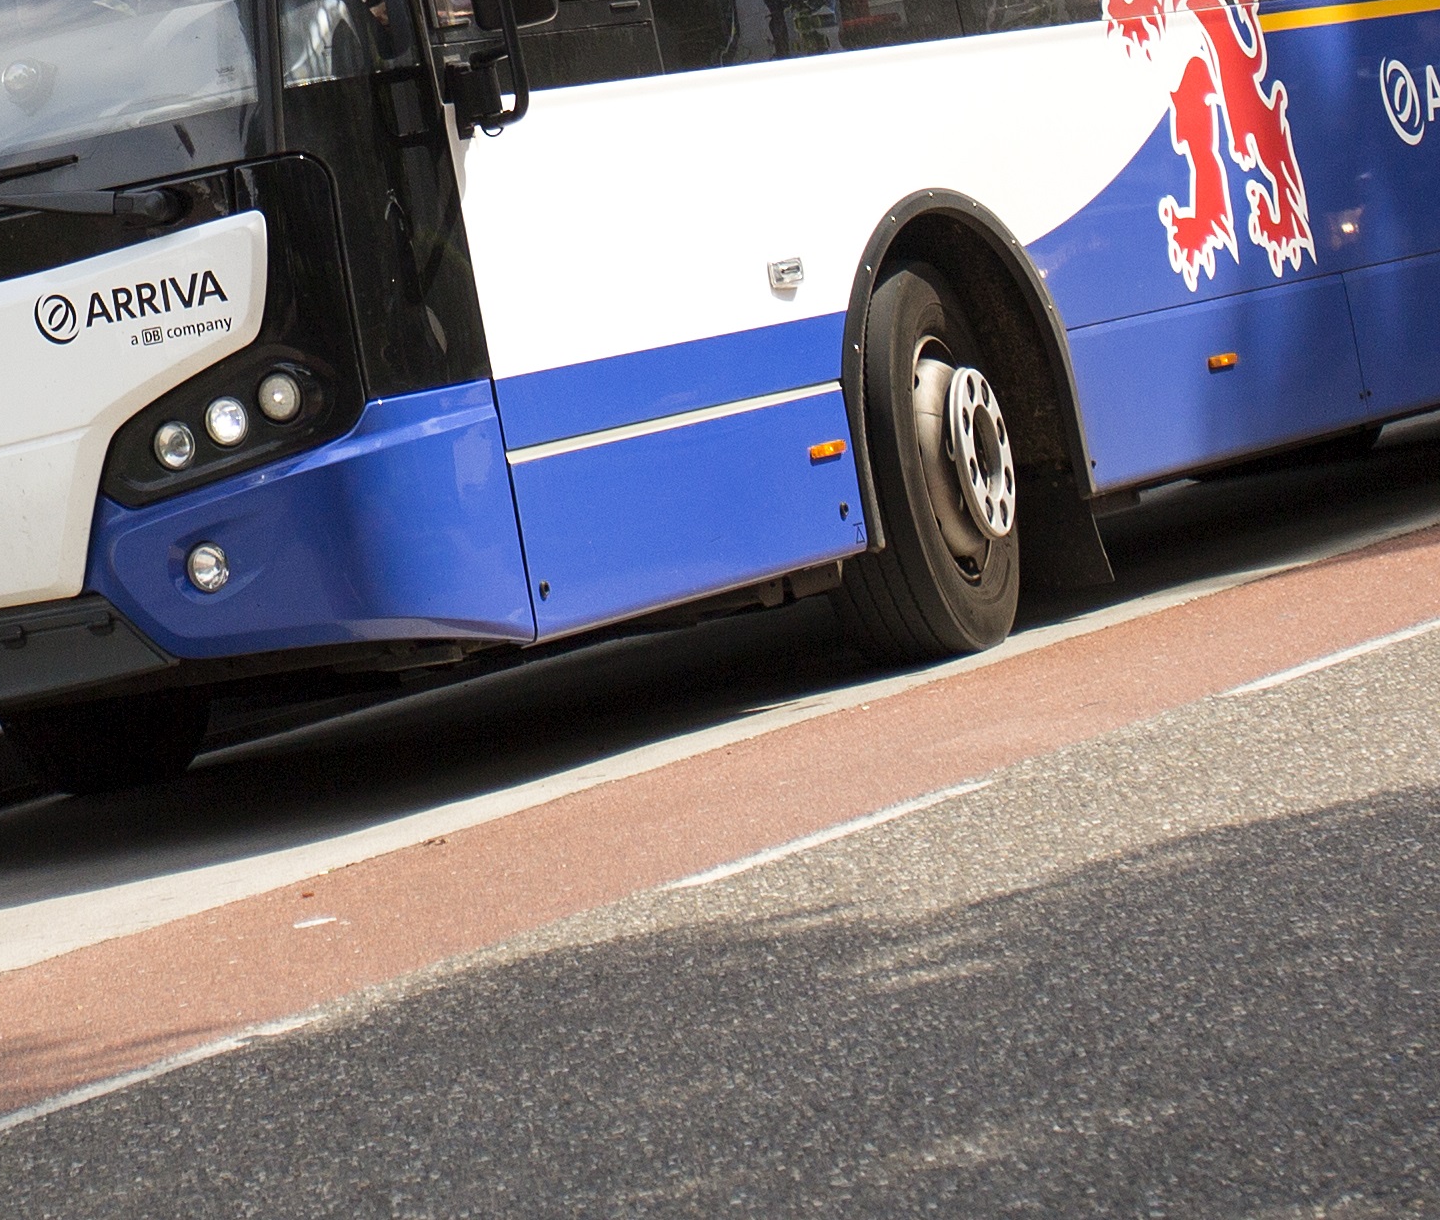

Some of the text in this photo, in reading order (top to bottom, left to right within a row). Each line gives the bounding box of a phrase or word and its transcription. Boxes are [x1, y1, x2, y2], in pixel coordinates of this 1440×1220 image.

[85, 270, 229, 328] ARRIVA
[130, 317, 233, 346] a DB company
